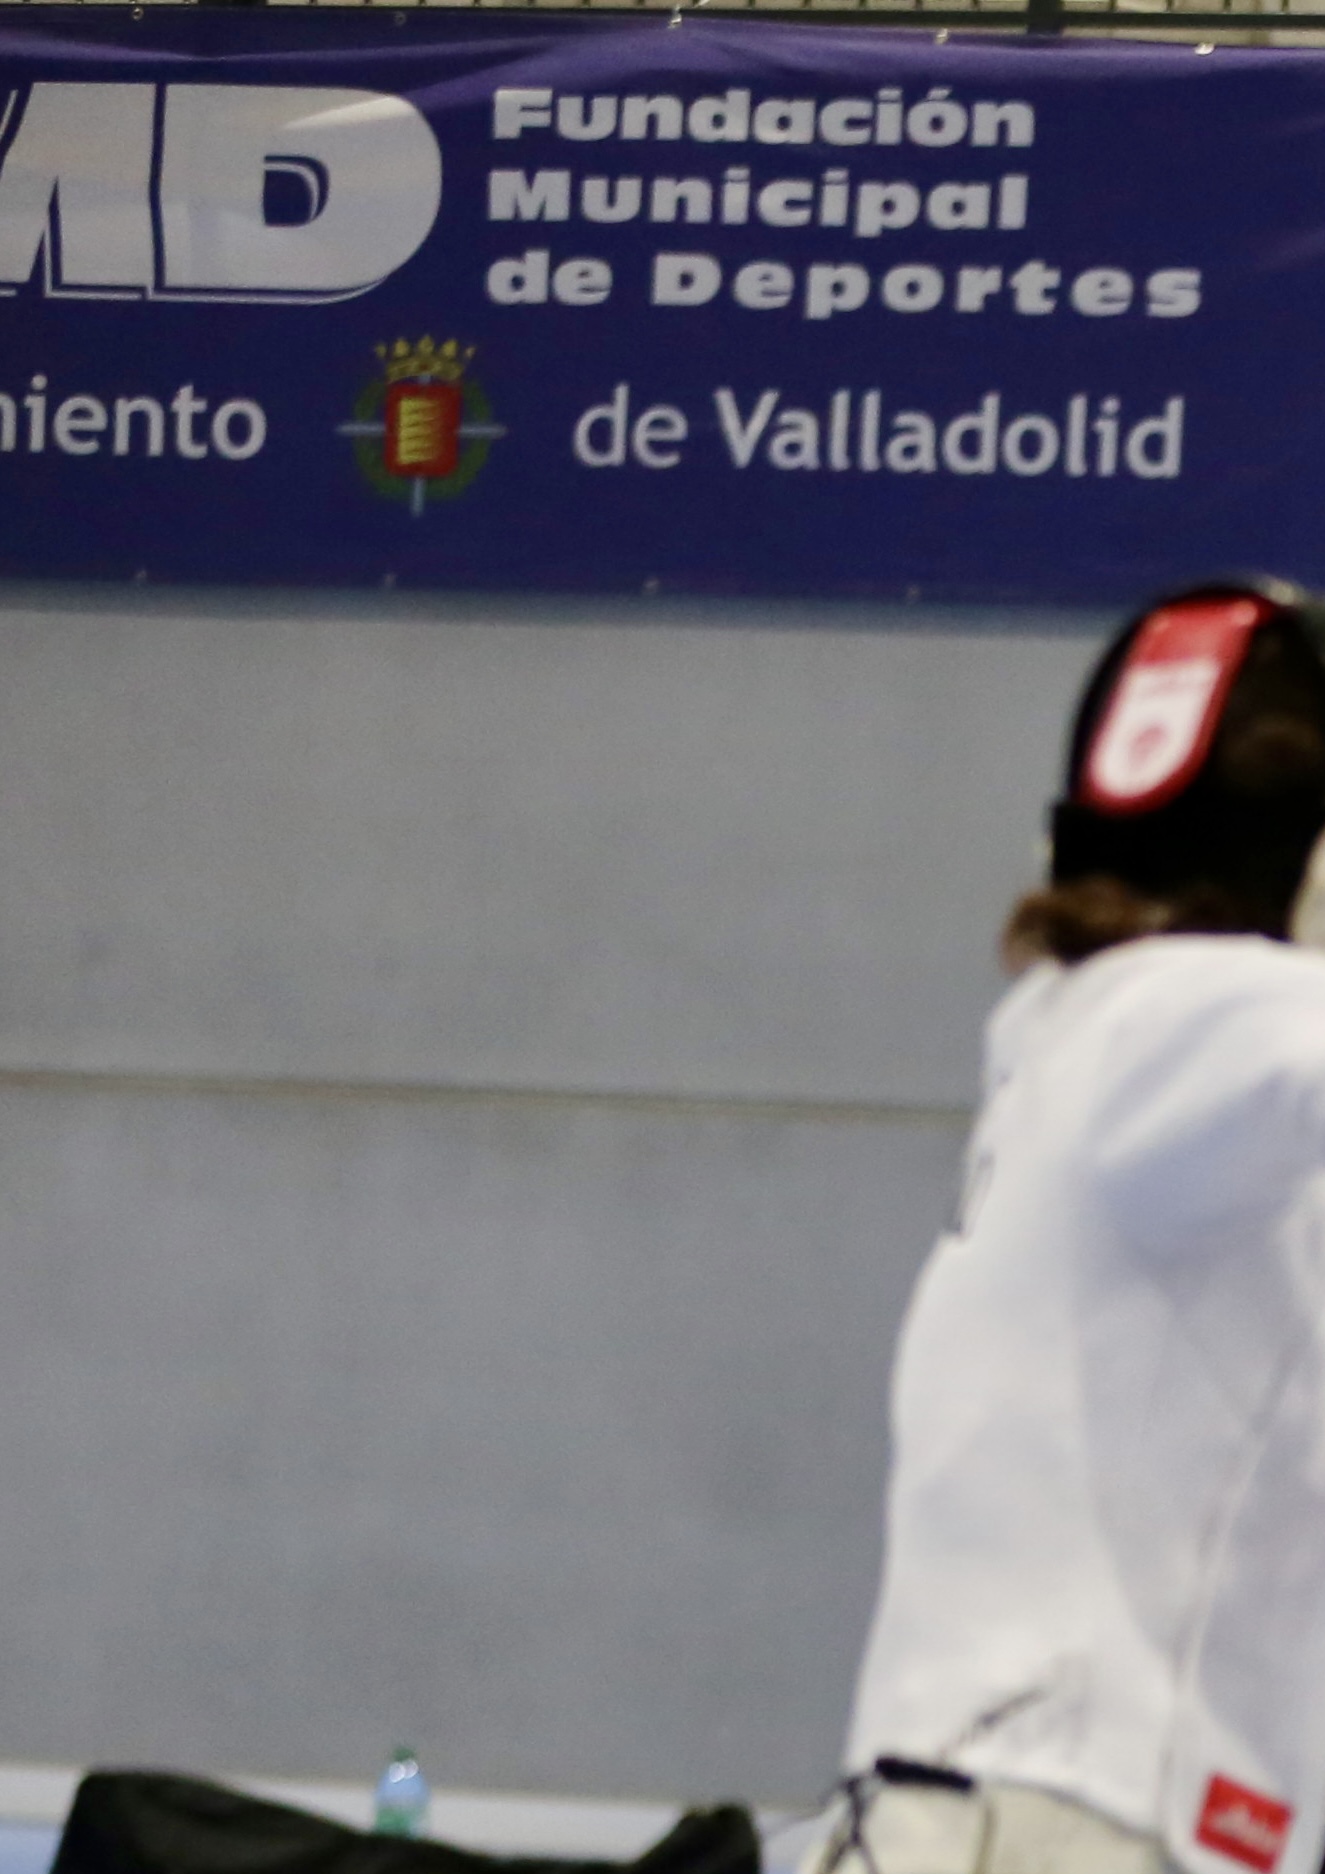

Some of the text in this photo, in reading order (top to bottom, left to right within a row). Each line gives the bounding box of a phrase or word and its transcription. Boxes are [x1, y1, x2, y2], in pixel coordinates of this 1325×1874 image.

[493, 85, 1035, 148] Fundación
[488, 167, 1029, 238] Municipal
[486, 250, 1202, 320] de Deportes
[574, 384, 688, 468] de
[714, 388, 1184, 479] Valladolid
